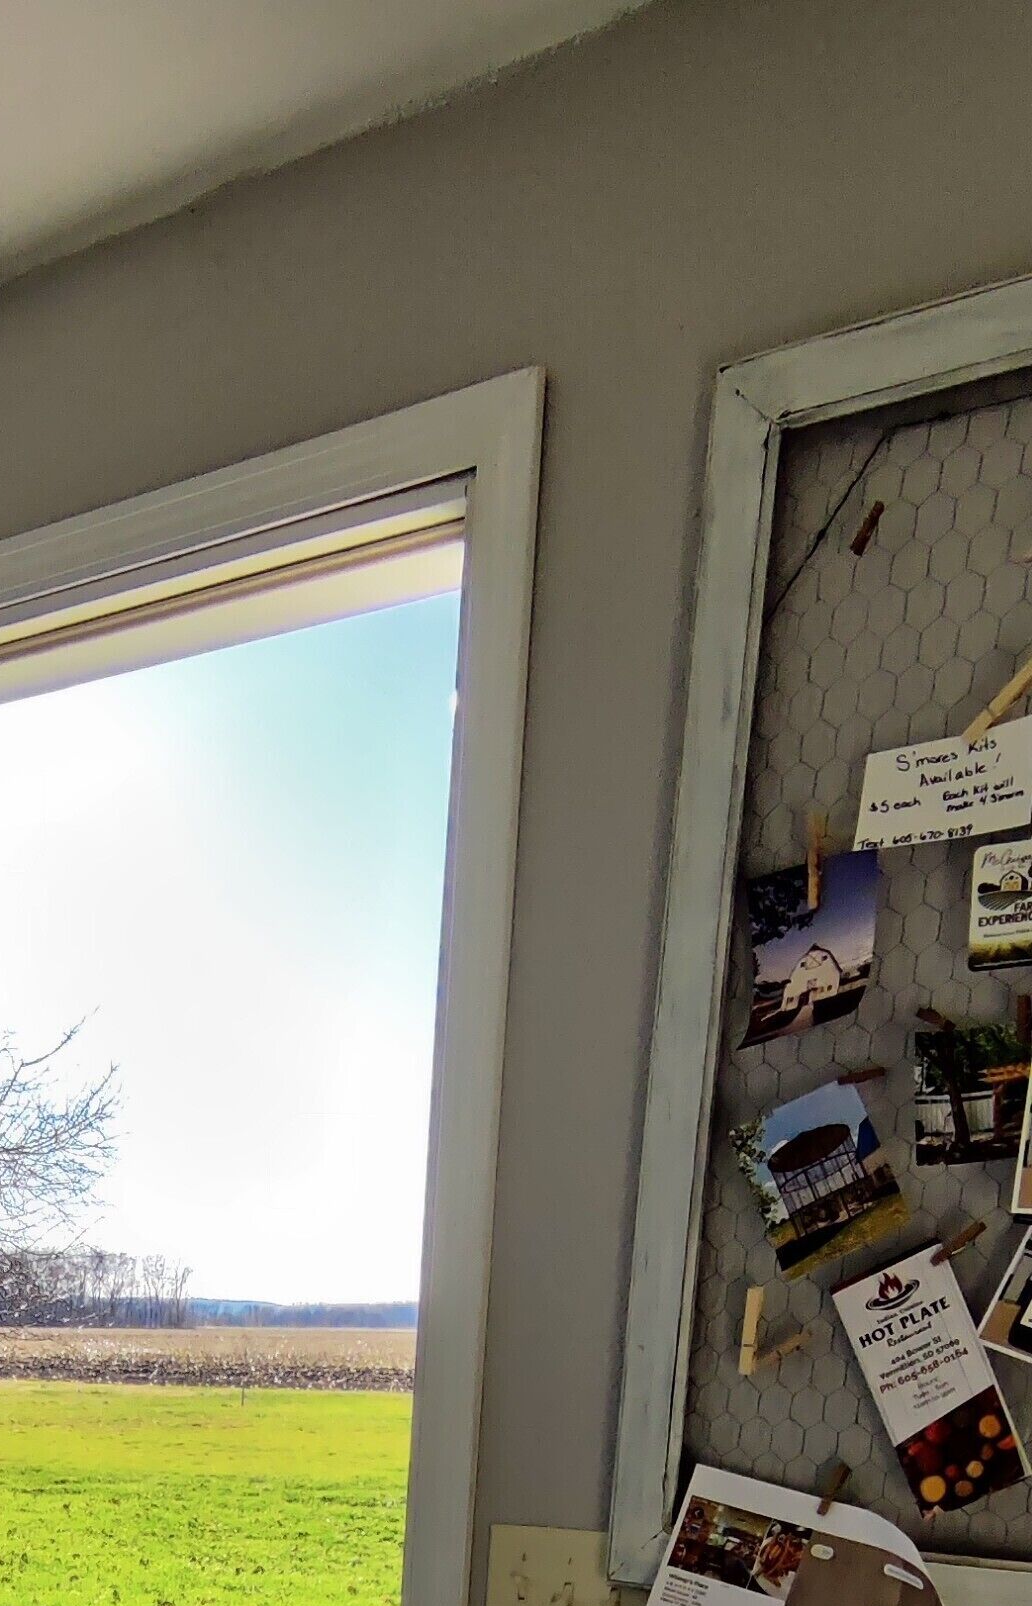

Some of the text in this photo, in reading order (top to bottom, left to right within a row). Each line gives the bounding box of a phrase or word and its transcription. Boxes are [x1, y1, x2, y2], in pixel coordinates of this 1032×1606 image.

[896, 738, 997, 772] S'mores Kits
[893, 797, 921, 810] each
[857, 837, 885, 850] Text
[858, 1296, 951, 1349] HOT PLATE
